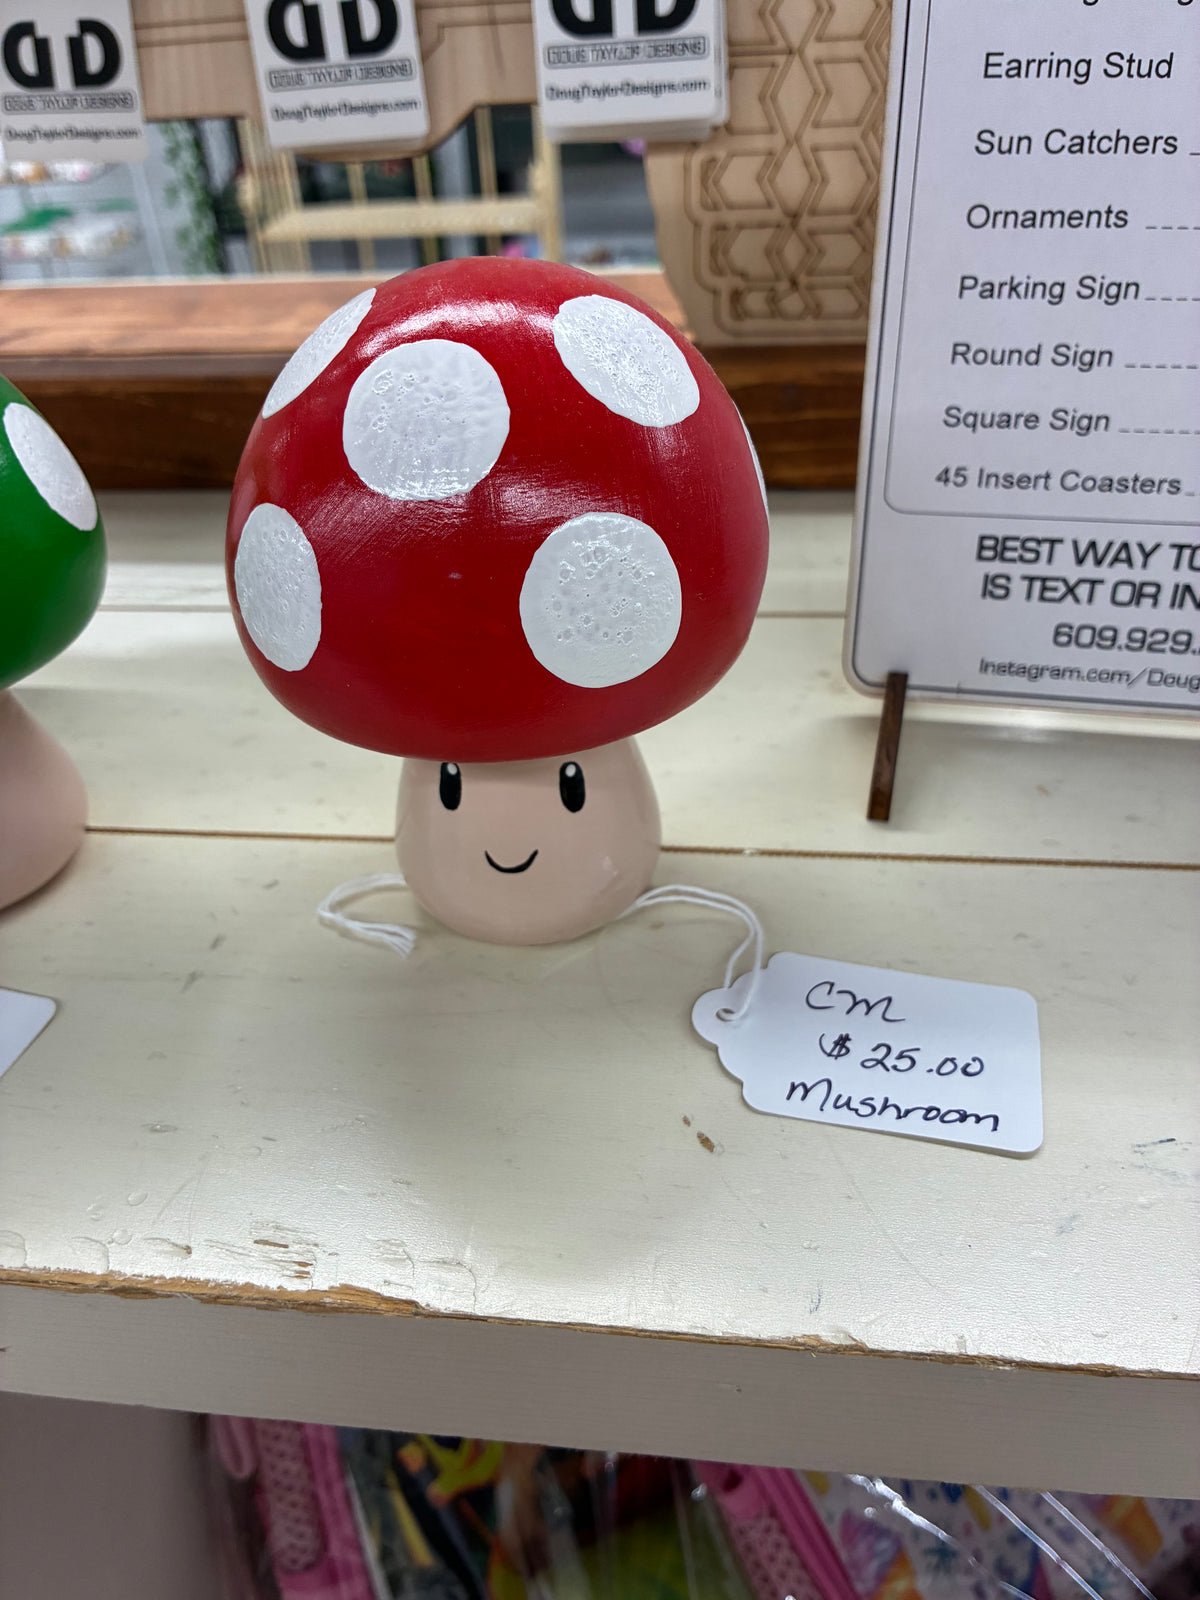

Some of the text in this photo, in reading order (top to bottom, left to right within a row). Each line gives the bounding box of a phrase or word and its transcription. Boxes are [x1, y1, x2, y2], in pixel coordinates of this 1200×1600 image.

[983, 51, 1174, 85] Earring Stud
[975, 128, 1178, 155] Sun Catchers
[966, 204, 1128, 229] Ornaments
[958, 275, 1140, 306] Parking Sign
[951, 342, 1113, 372] Round Sign
[943, 406, 1110, 437] Square Sign
[935, 467, 1181, 495] 45 Insert Coasters
[976, 534, 1064, 565] BEST
[1072, 539, 1162, 570] WAY
[981, 573, 1012, 600] IS
[1020, 575, 1105, 605] TEXT
[1110, 579, 1162, 609] OR
[1053, 623, 1200, 655] 609.929.
[786, 1078, 999, 1131] Mushroom
